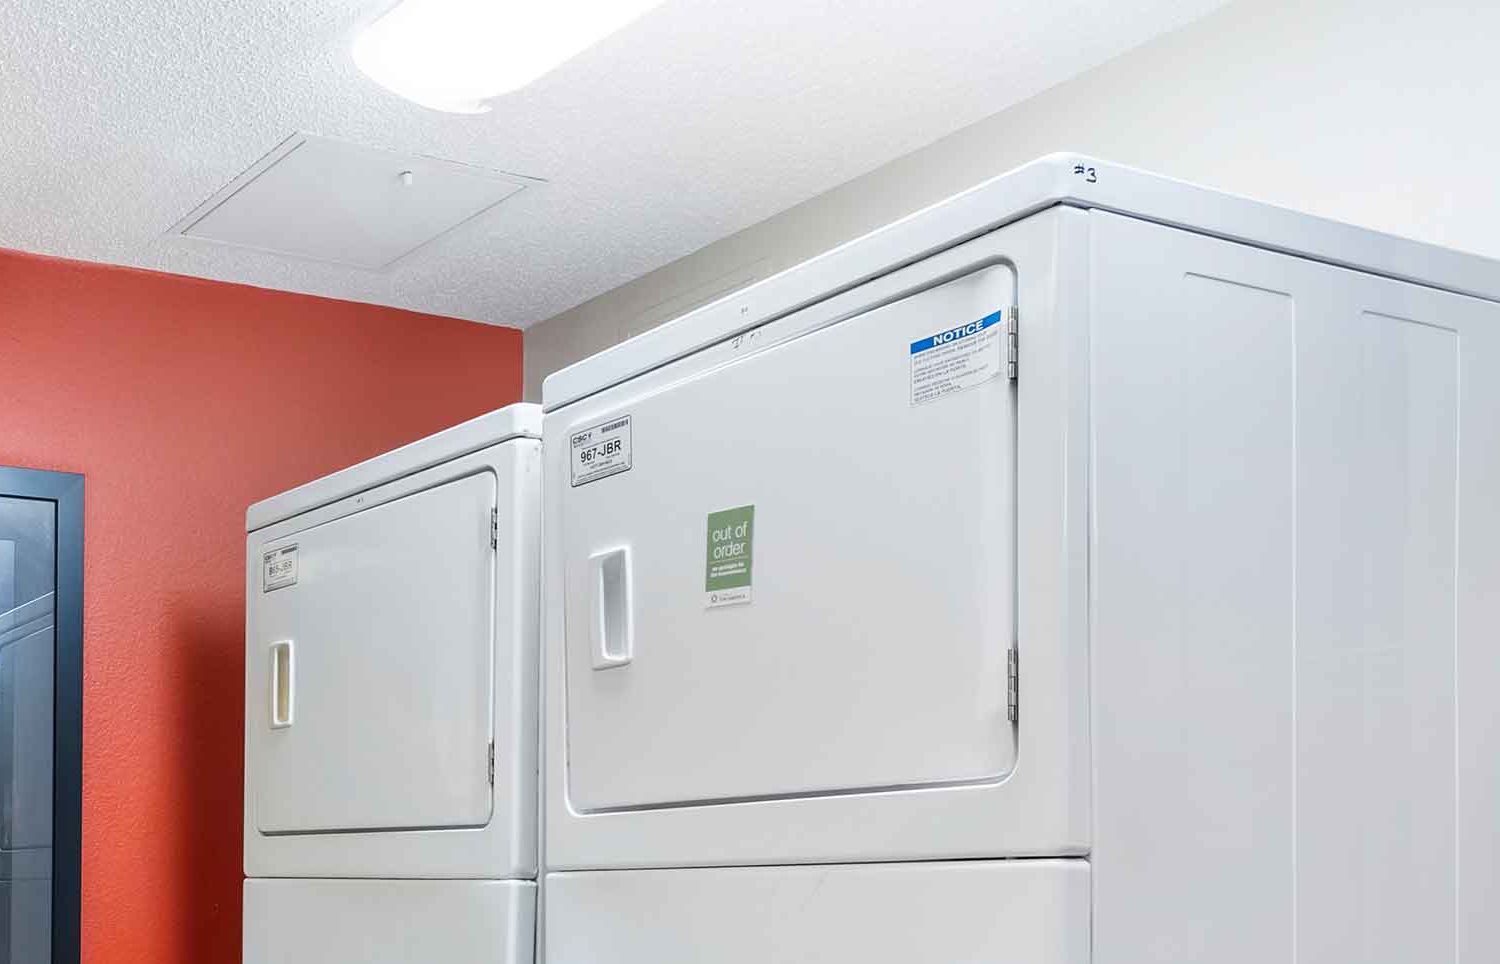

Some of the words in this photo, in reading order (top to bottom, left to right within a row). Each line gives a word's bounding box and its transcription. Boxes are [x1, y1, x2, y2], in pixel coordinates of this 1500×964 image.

[1074, 163, 1097, 183] #3
[933, 319, 984, 346] NOTICE
[580, 439, 621, 463] 967-JBR
[712, 525, 732, 542] out
[734, 520, 748, 538] of
[713, 542, 747, 559] order
